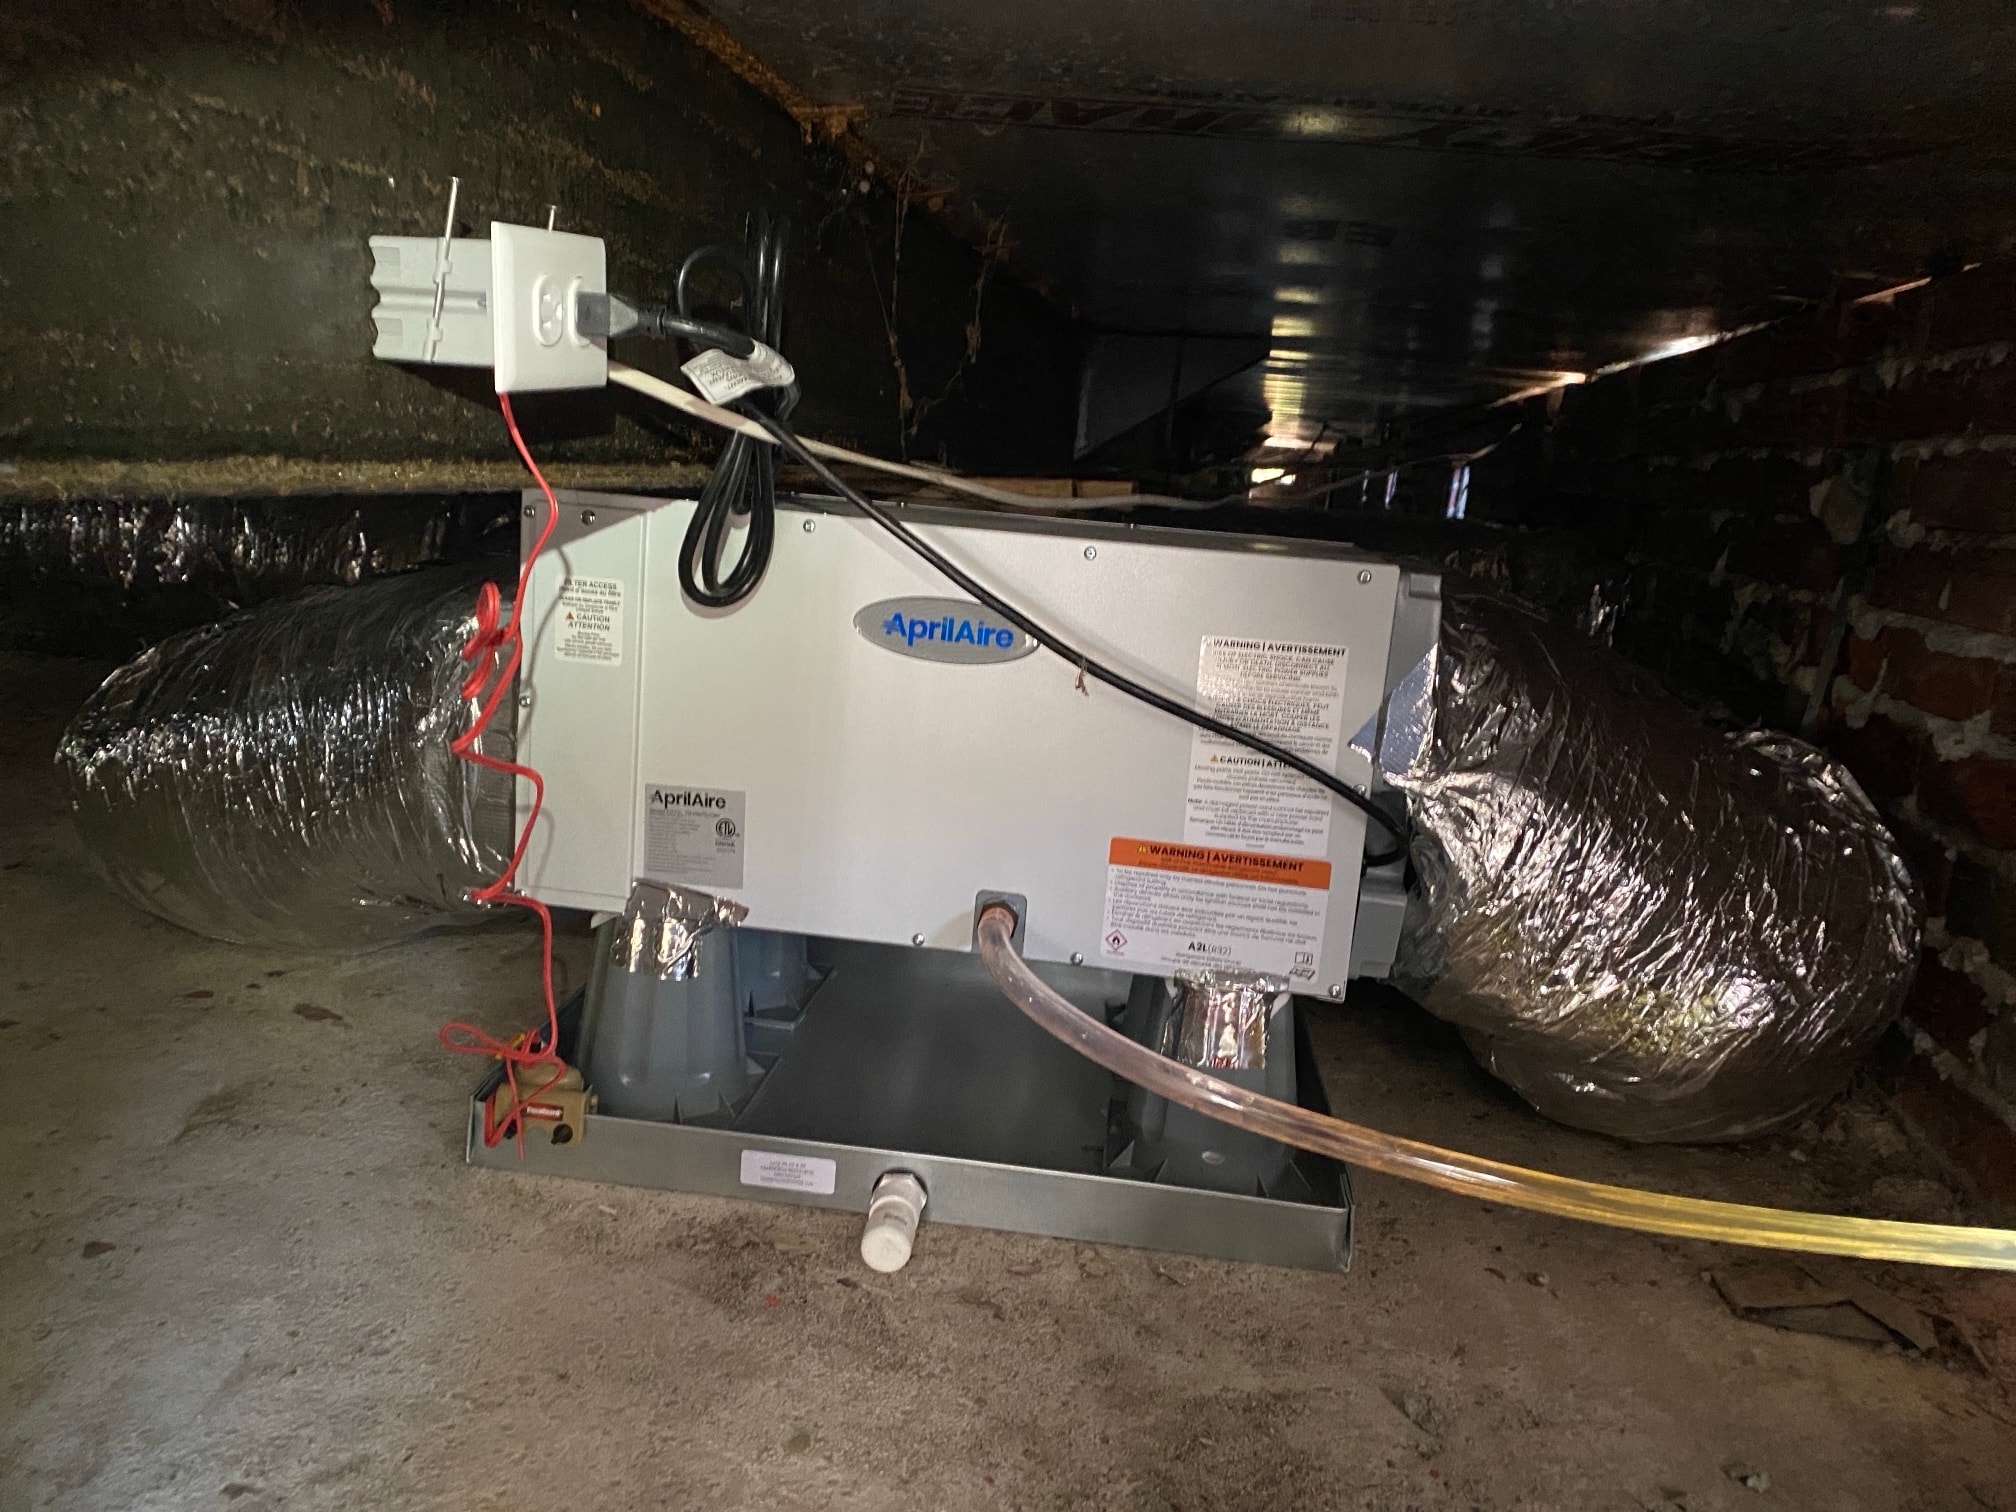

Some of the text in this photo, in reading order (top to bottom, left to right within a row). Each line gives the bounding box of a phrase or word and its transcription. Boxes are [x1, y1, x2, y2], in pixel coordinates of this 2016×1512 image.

[589, 581, 617, 590] ACCESS
[577, 613, 610, 622] CAUTION
[568, 622, 610, 632] ATTENTION
[883, 611, 1014, 649] AprilAire
[1214, 638, 1346, 657] WARNING AVERTISSEMENT
[1220, 756, 1260, 767] CAUTION
[650, 790, 726, 809] AprilAire
[1150, 845, 1204, 860] WARNING
[1213, 851, 1304, 872] AVERTISSEMENT
